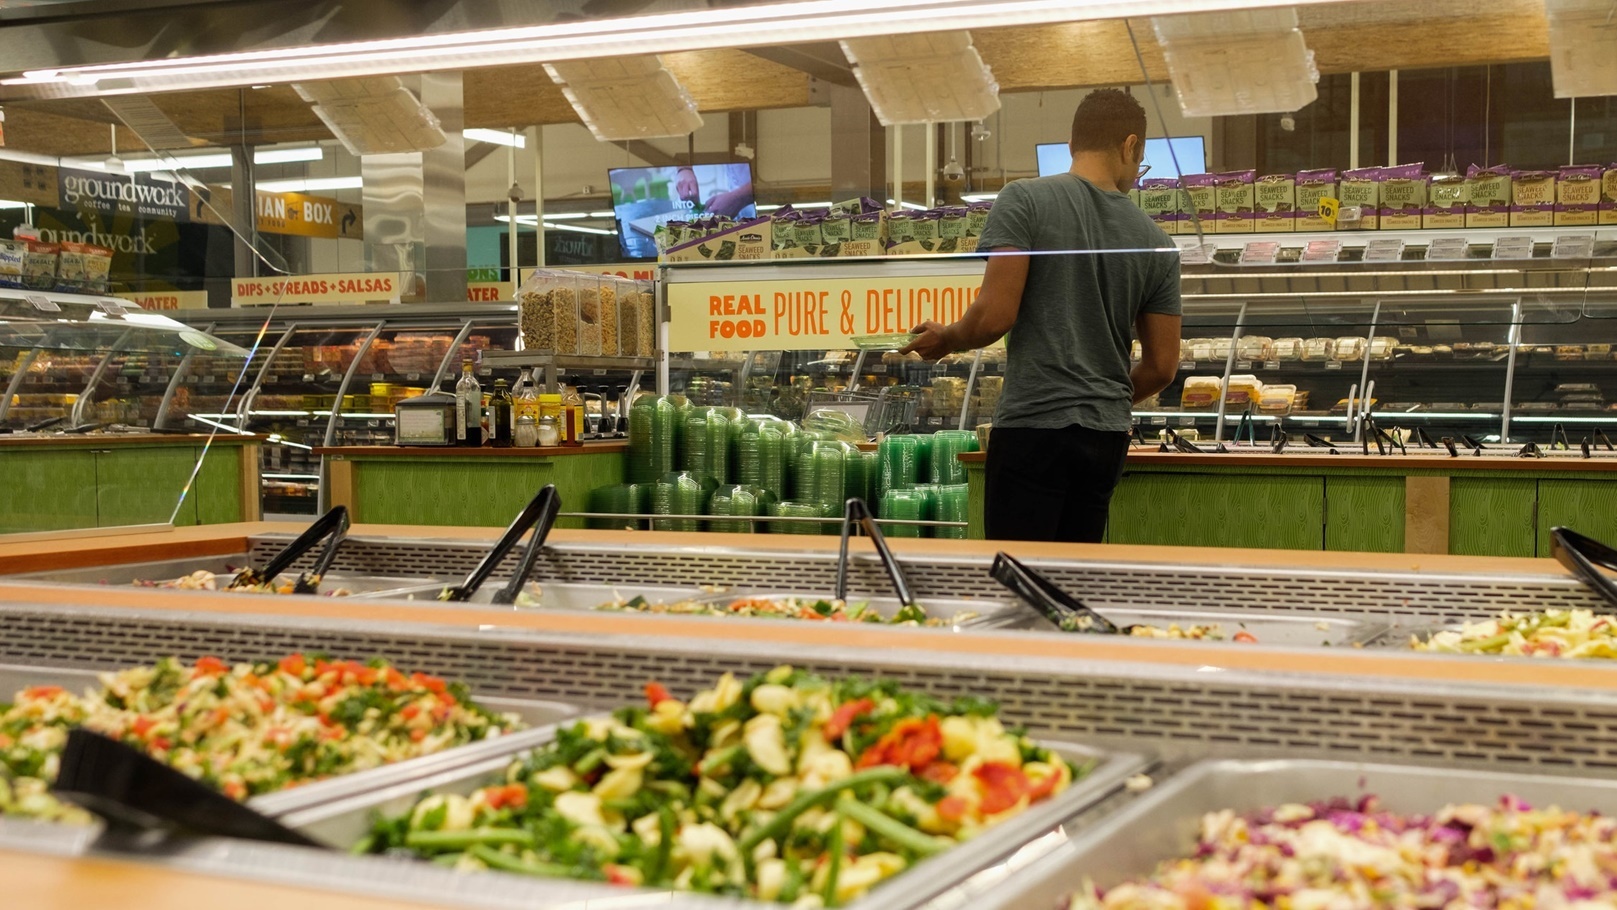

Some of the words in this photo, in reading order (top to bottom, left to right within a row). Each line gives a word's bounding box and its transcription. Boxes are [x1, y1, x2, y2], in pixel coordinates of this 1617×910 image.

[64, 173, 186, 207] groundwork
[1260, 185, 1287, 194] SEAWEED
[1471, 182, 1500, 191] SEAWEED
[1563, 186, 1593, 194] SEAWEED
[1221, 190, 1247, 199] SEAWEED
[1301, 190, 1328, 198] SEAWEED
[1471, 190, 1496, 199] SNACKS
[1563, 193, 1589, 201] SNACKS
[84, 200, 111, 210] coffee
[118, 203, 131, 212] tea
[138, 205, 178, 218] community
[258, 196, 286, 219] IAN
[303, 201, 333, 225] BOX
[672, 200, 695, 210] INTO
[40, 222, 157, 254] oundwork
[844, 242, 870, 250] SEAWEED
[466, 268, 499, 281] ONS
[237, 282, 263, 297] DIPS
[272, 280, 328, 296] SPREADS
[338, 278, 392, 293] SALSAS
[467, 287, 499, 302] ATER
[134, 296, 179, 311] WATER
[709, 294, 767, 316] REAL
[774, 291, 830, 337] PURE
[840, 289, 856, 335] &
[709, 319, 767, 339] FOOD
